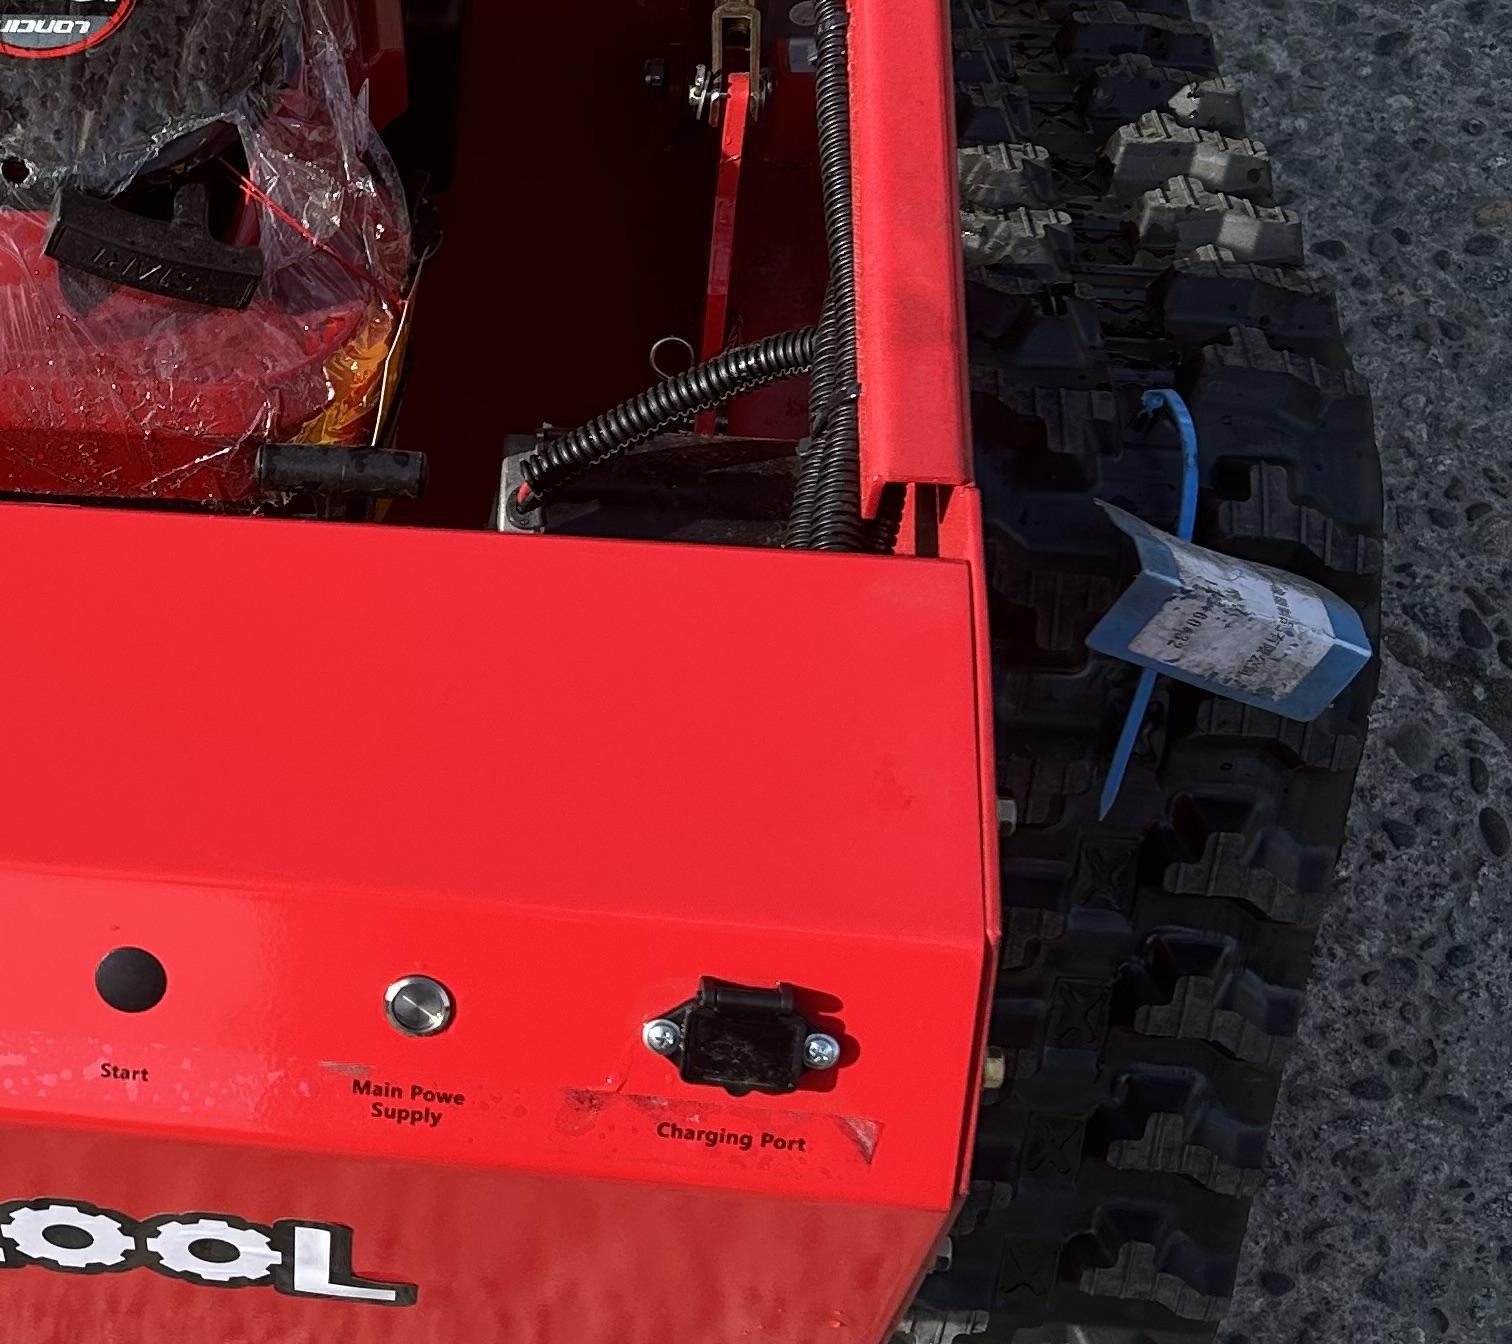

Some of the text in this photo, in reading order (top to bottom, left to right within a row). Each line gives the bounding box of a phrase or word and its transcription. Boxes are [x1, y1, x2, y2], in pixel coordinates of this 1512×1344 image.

[99, 1062, 150, 1083] Start
[351, 1078, 466, 1106] Main Powe
[370, 1102, 443, 1128] Supply
[656, 1121, 807, 1152] Charging Port
